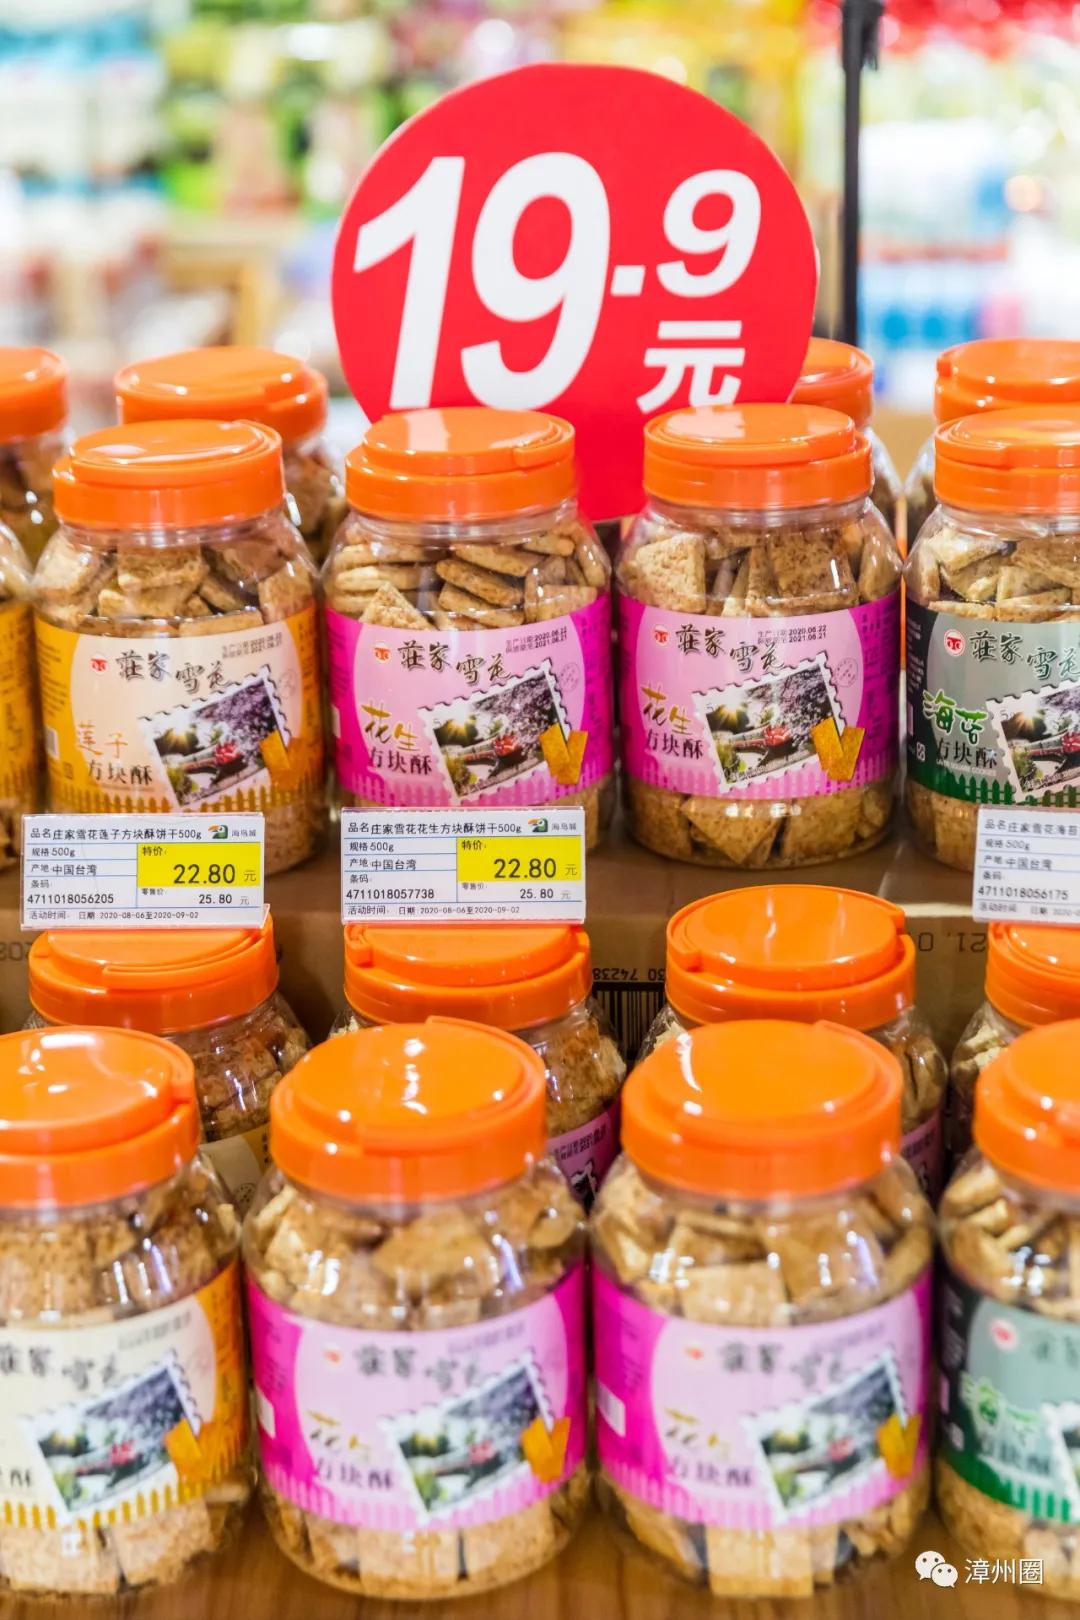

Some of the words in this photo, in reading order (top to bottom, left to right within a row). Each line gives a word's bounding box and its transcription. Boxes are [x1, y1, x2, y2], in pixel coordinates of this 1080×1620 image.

[353, 151, 761, 411] 19.9
[636, 320, 746, 414] 元
[641, 683, 692, 736] 花生
[922, 689, 988, 745] 海苔
[361, 700, 421, 752] 花生
[646, 728, 704, 760] 方块酥
[938, 737, 998, 769] 方块酥
[89, 759, 153, 786] 方块酥
[369, 747, 432, 775] 方块酥
[52, 864, 97, 876] 中国台湾
[173, 864, 236, 885] 22.80
[244, 869, 257, 882] 元
[371, 859, 417, 871] 中国台湾
[493, 858, 557, 879] 22.80
[564, 863, 578, 876] 元
[27, 893, 114, 904] 4711018056205
[346, 888, 435, 899] 4711018057738
[978, 885, 1069, 900] 4711018056175
